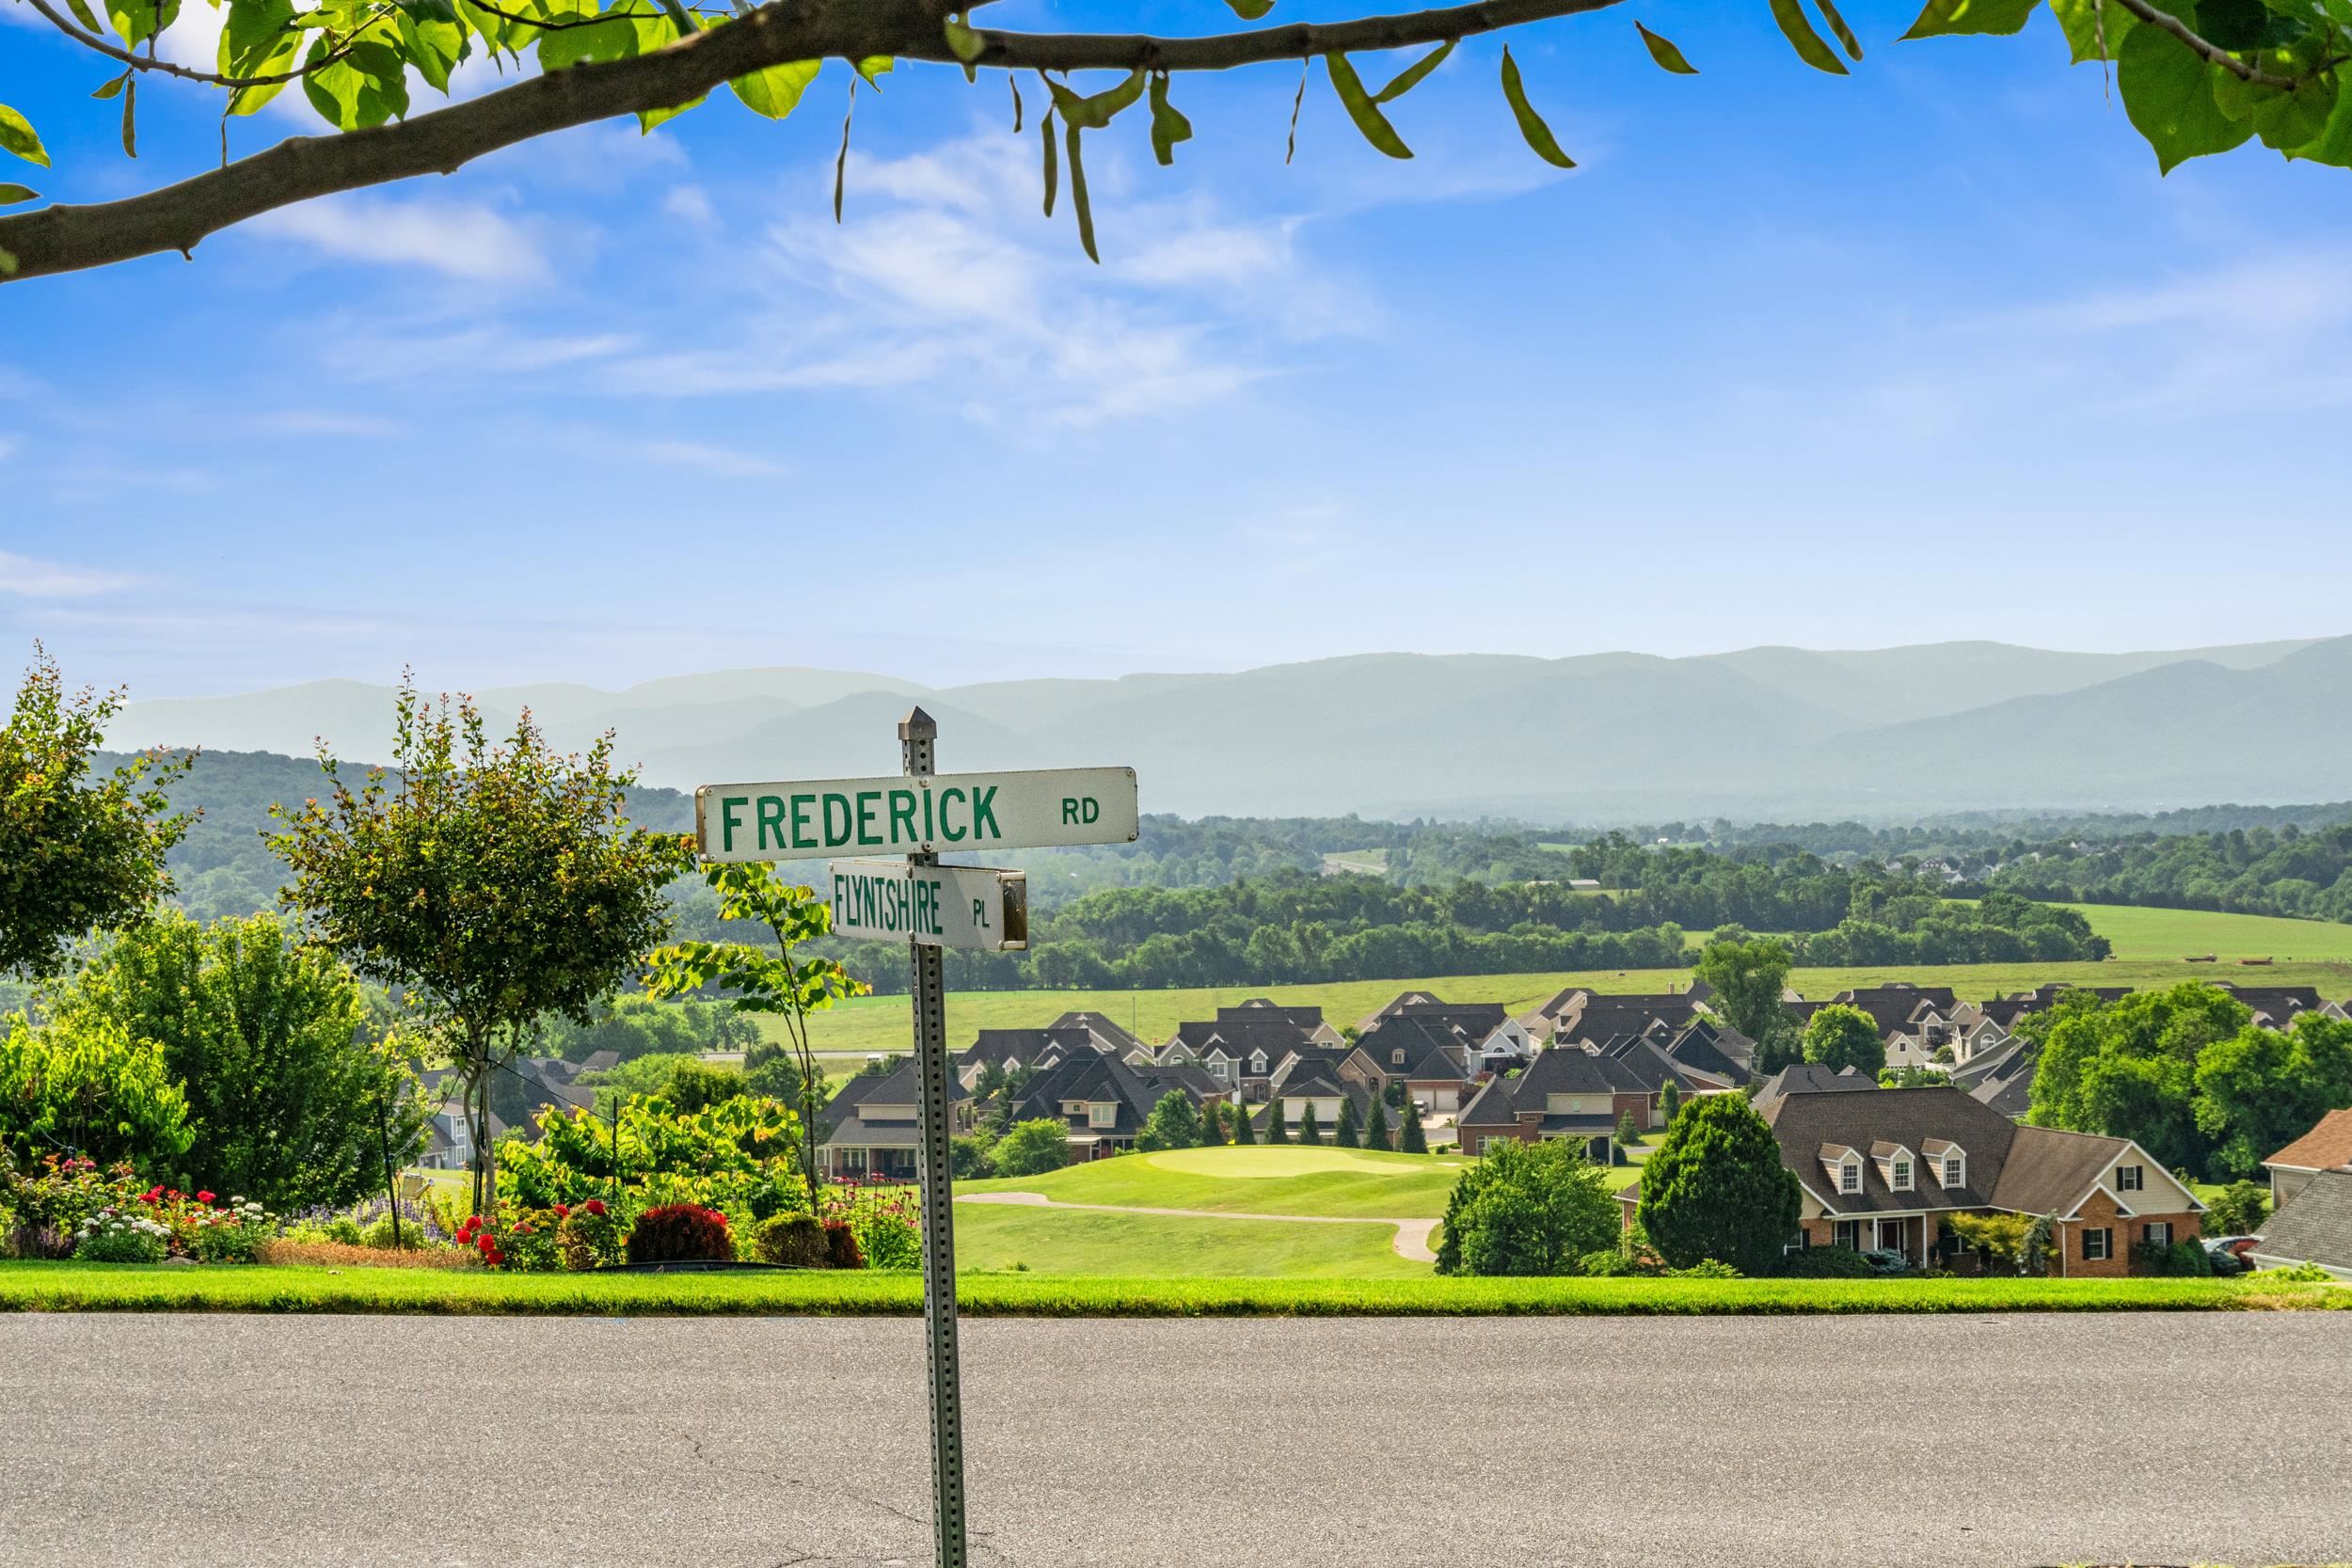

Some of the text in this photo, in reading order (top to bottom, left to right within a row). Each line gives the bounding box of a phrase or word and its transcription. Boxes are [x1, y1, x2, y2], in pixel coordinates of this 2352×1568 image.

[723, 786, 1100, 852] FREDERICK RD
[834, 874, 991, 934] FLYNTSHIRE PL
